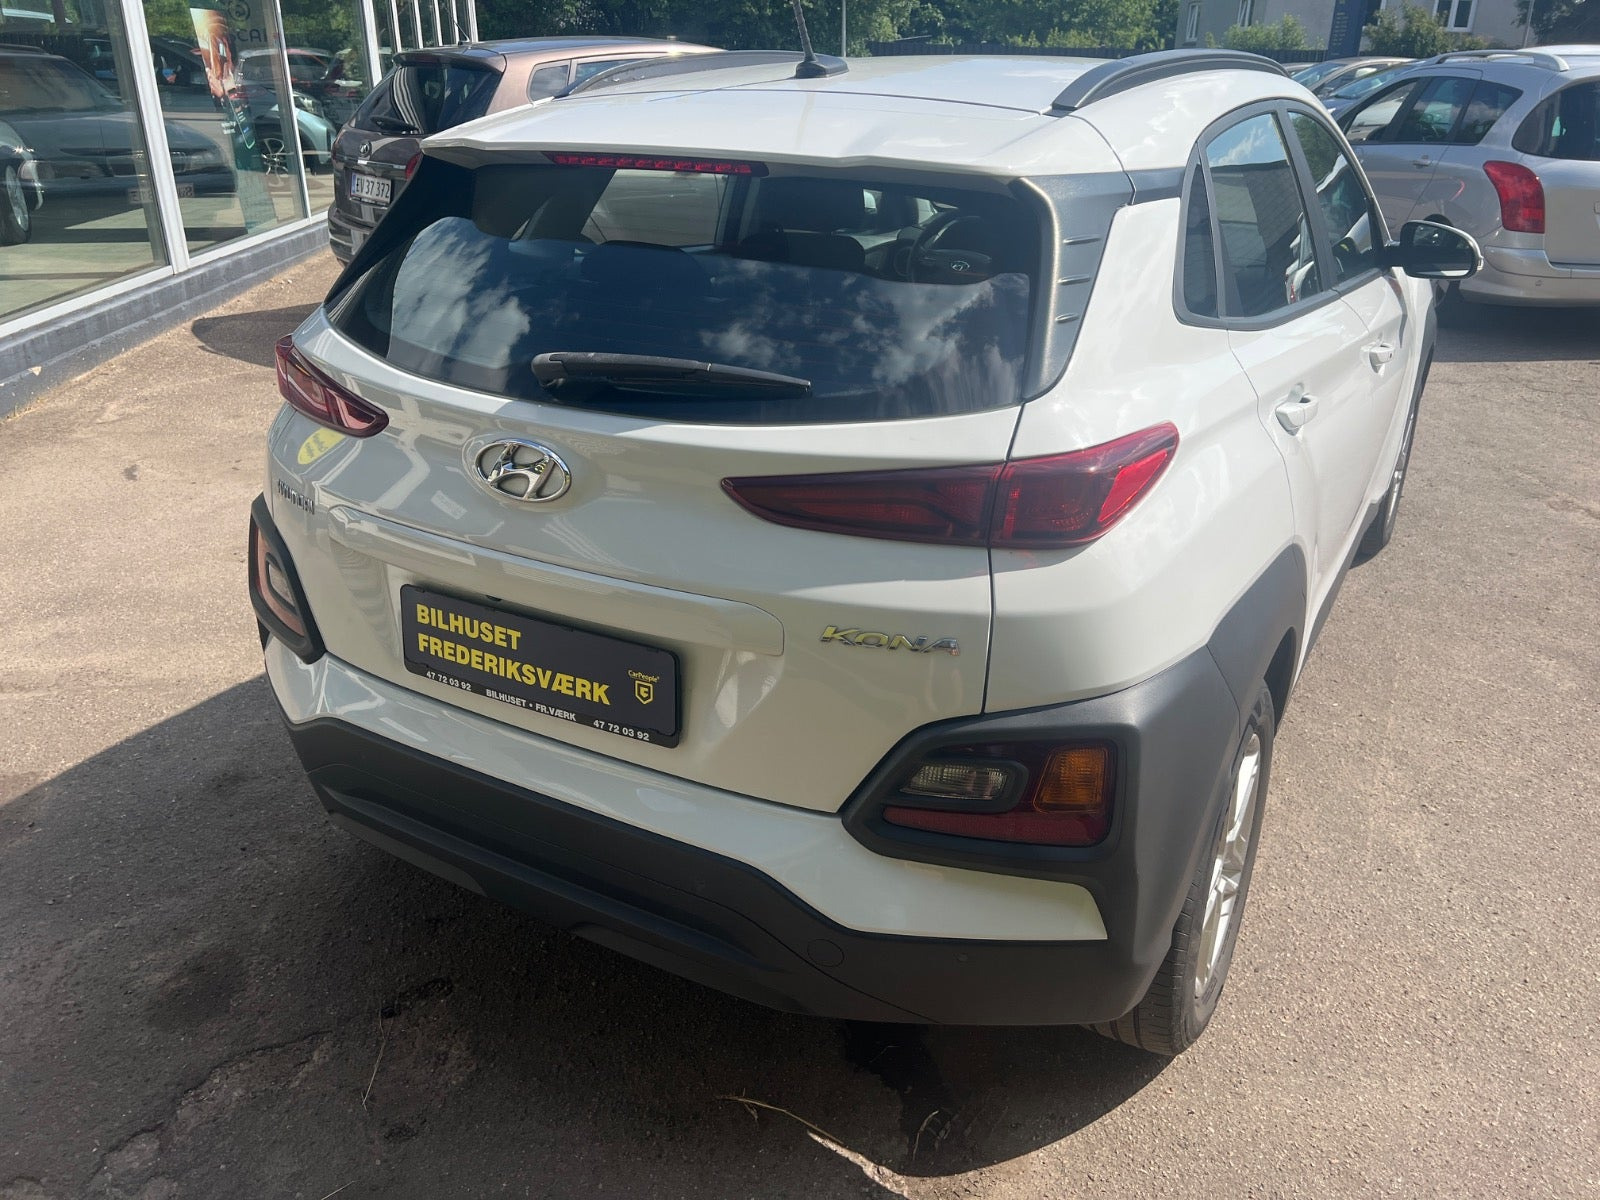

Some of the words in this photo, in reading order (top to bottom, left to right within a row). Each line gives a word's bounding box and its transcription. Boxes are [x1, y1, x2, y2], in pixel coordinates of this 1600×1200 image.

[356, 177, 365, 193] EV
[366, 180, 375, 195] 37
[376, 182, 390, 198] 372
[416, 603, 521, 650] BILHUSET
[820, 625, 960, 656] KONA
[417, 631, 611, 706] FREDERIKSVÆRK
[426, 670, 435, 679] 47
[438, 673, 448, 683] 72
[449, 678, 460, 688] 03
[461, 681, 472, 691] 92
[486, 688, 527, 707] BILHUSET
[535, 703, 577, 722] FR.VÆRK
[593, 719, 605, 729] 47
[608, 723, 620, 733] 72
[622, 727, 634, 737] 03
[637, 731, 650, 741] 92
